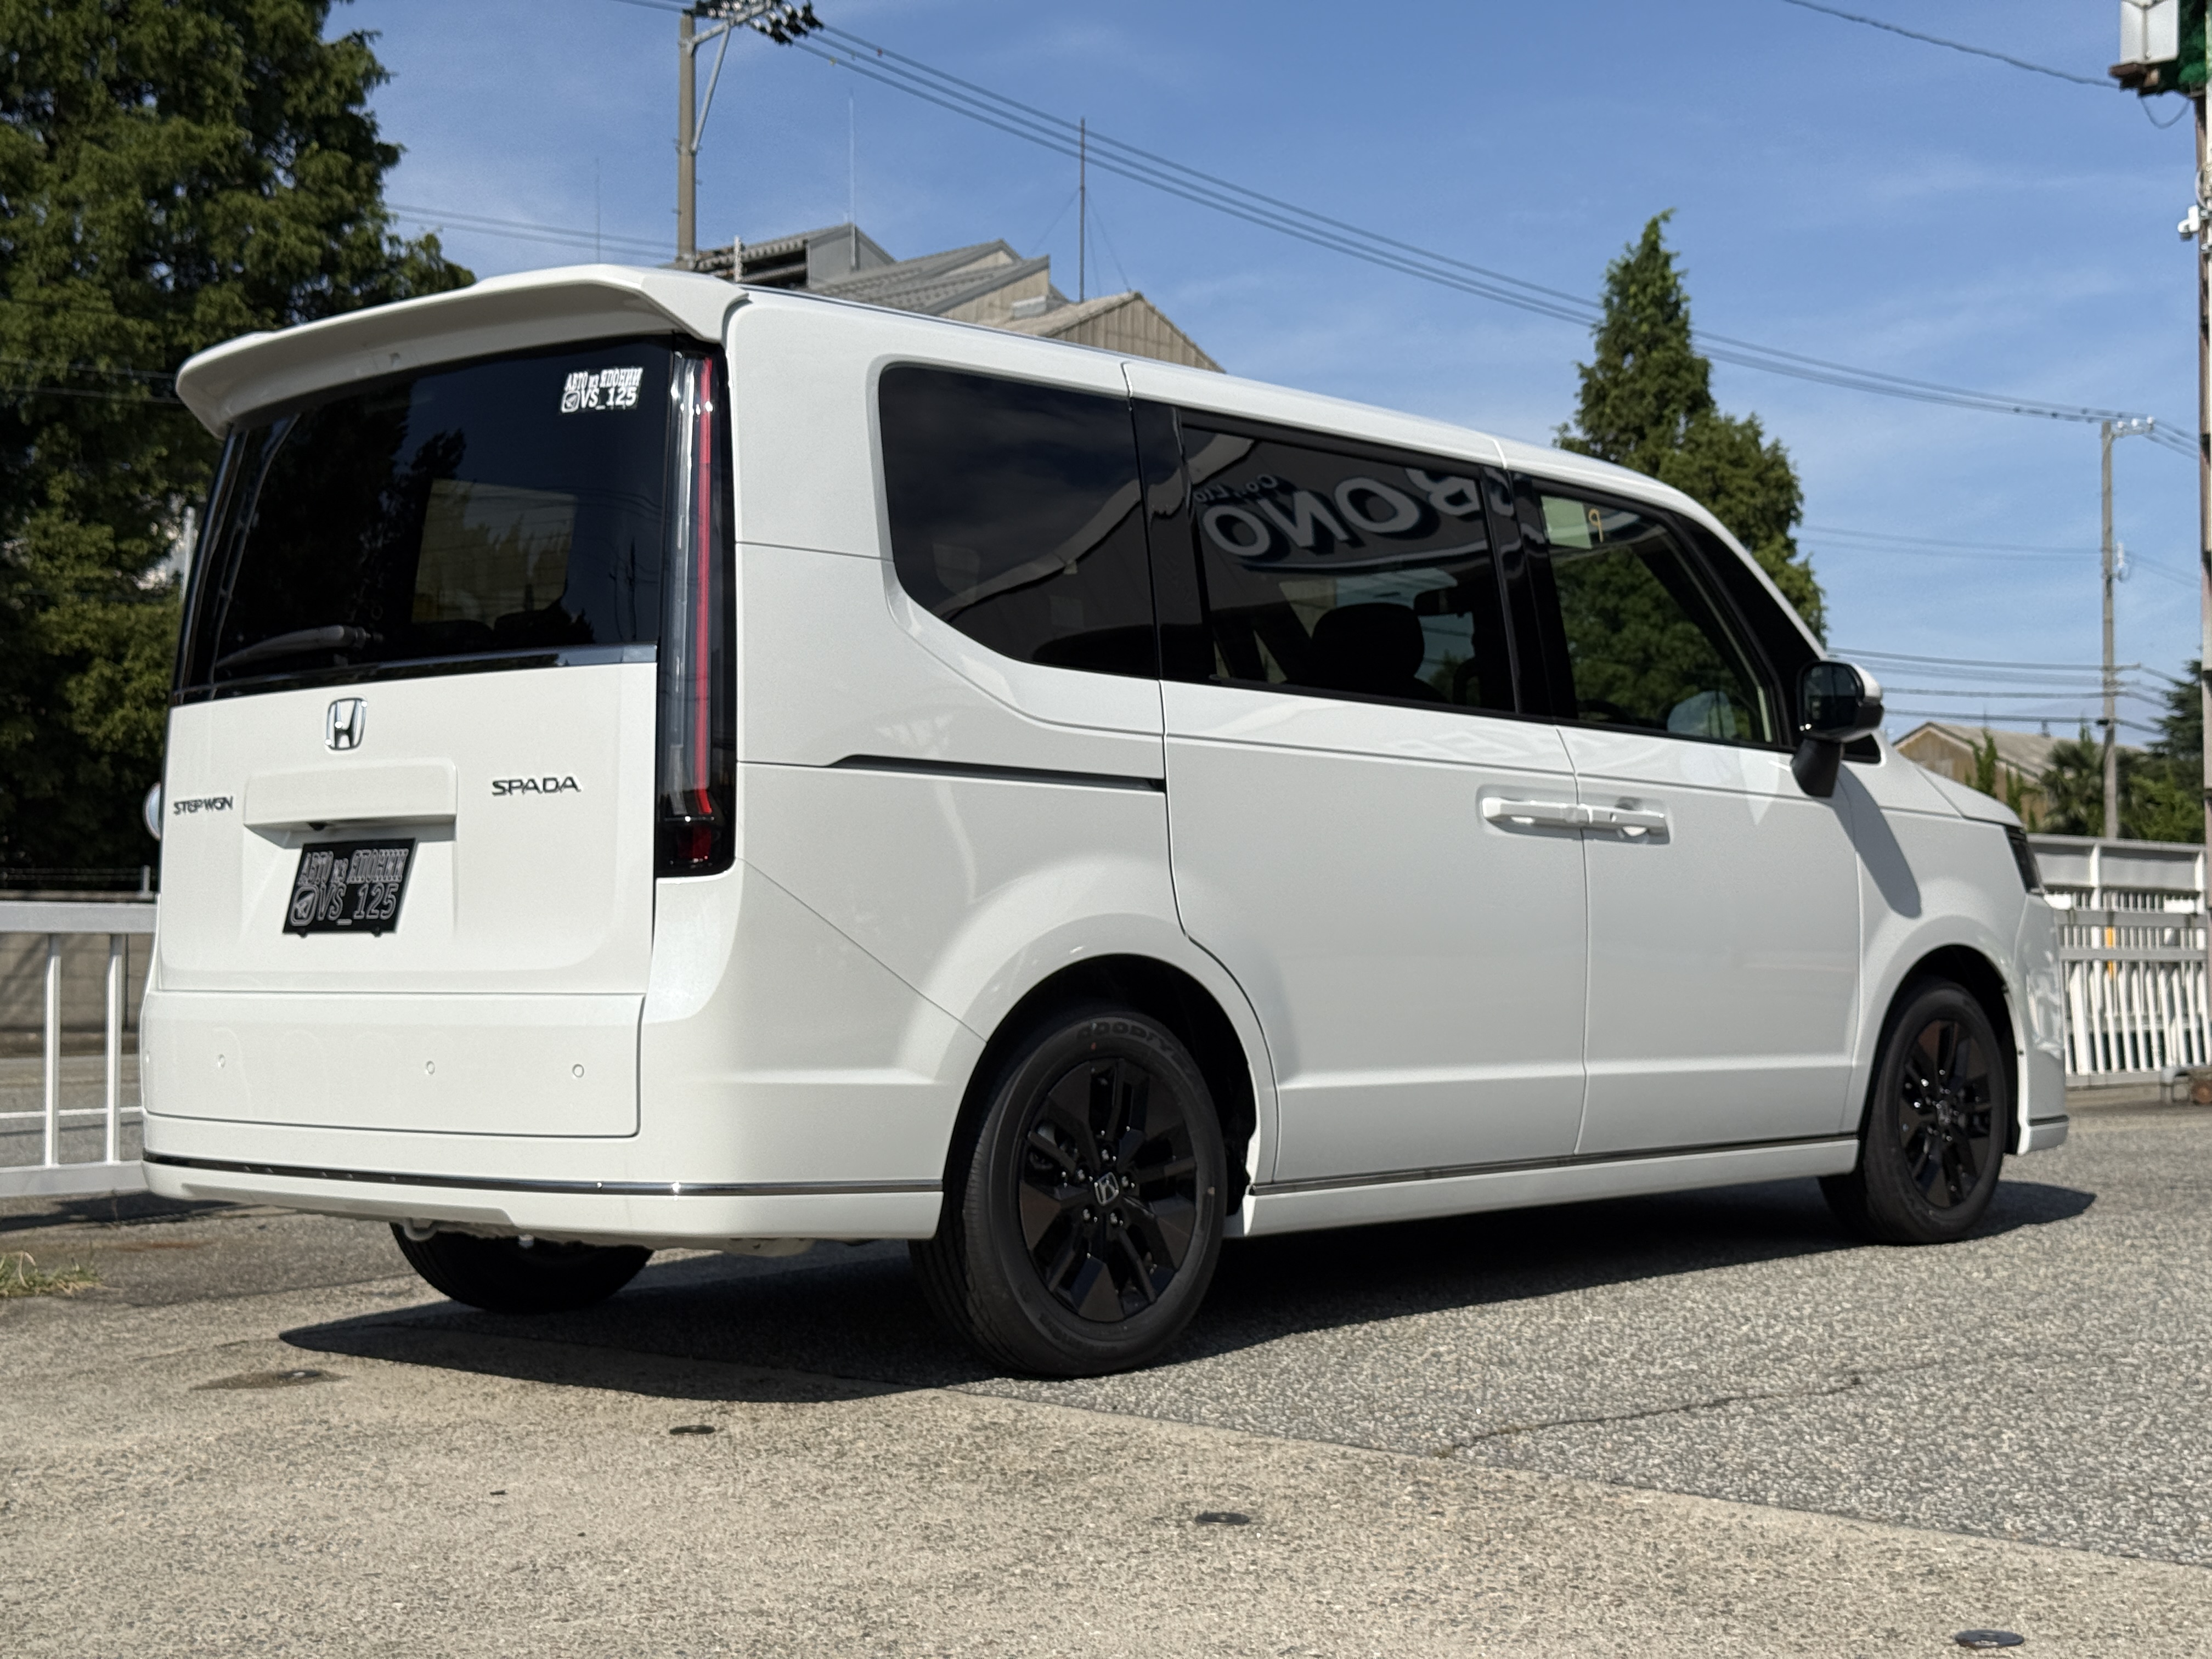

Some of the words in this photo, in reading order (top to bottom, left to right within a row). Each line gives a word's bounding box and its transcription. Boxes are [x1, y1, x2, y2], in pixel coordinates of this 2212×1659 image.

[581, 386, 637, 410] VS_125
[492, 776, 582, 795] SPADA
[317, 883, 399, 926] VS_125
